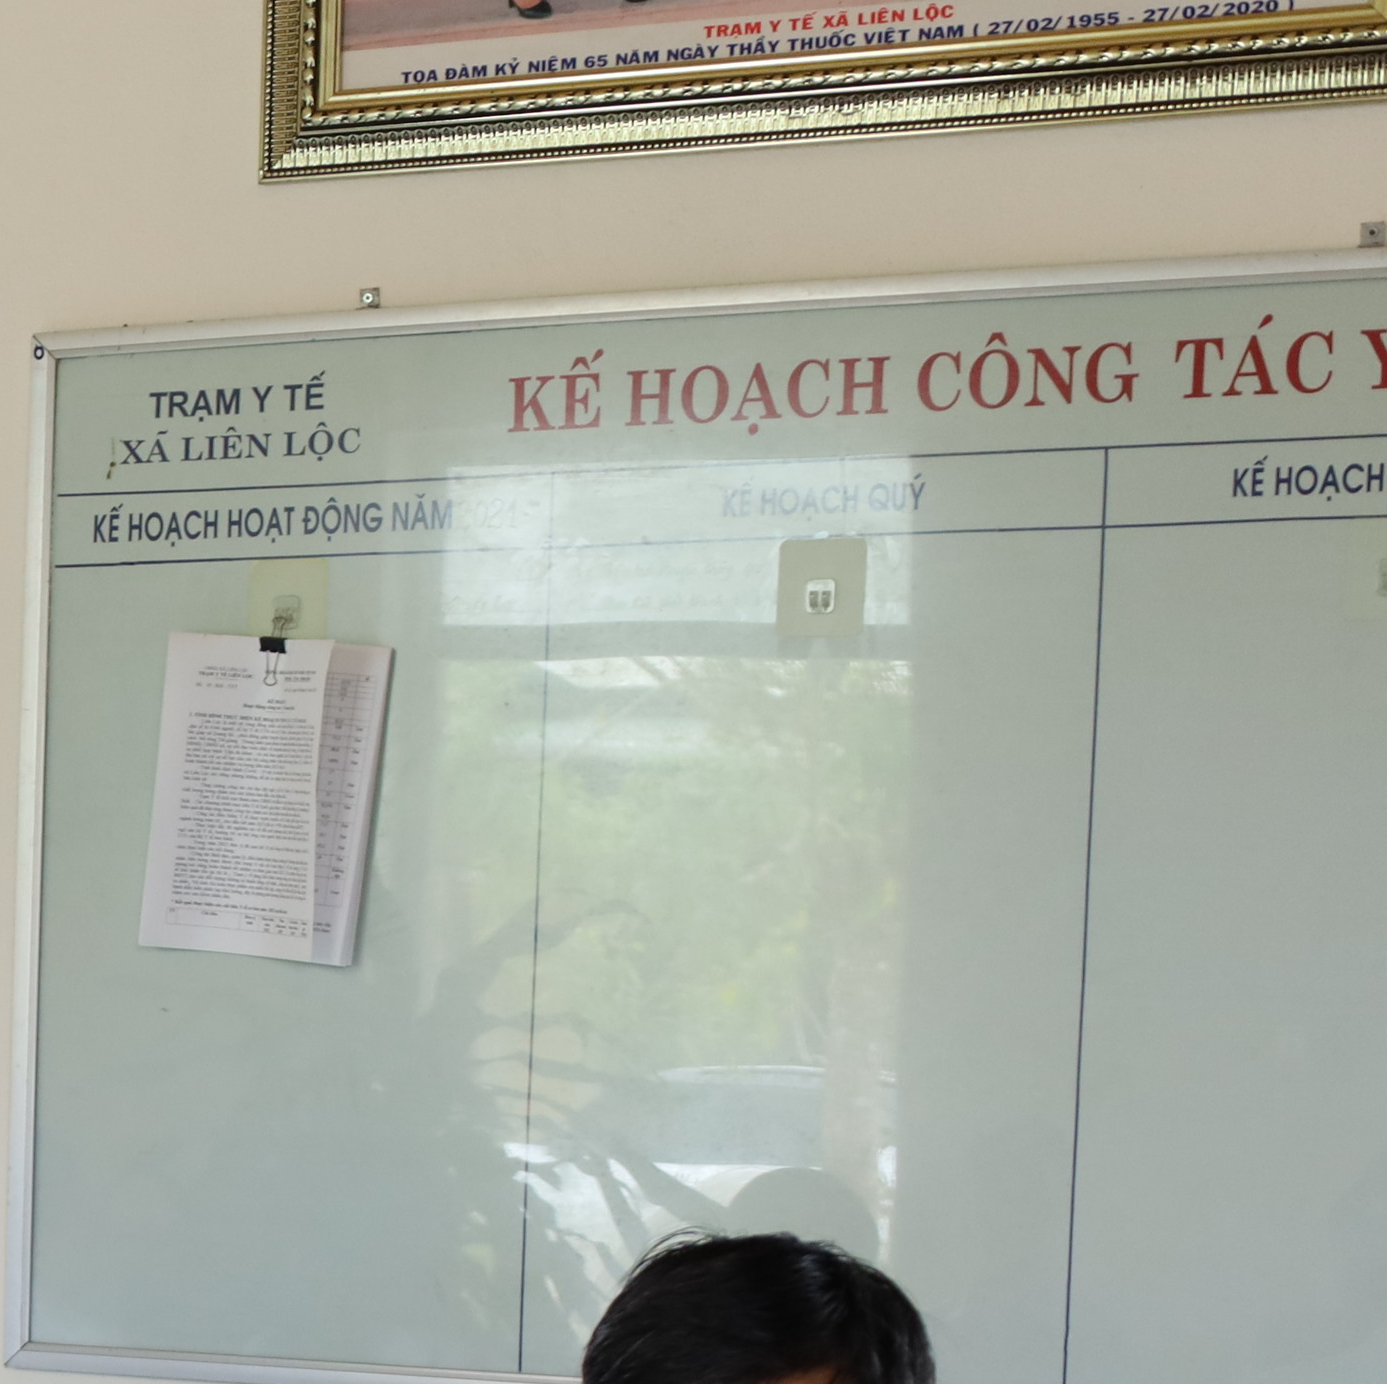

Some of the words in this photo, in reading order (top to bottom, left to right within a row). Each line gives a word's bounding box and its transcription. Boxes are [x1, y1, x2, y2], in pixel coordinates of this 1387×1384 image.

[401, 68, 439, 86] TỌA
[445, 59, 488, 81] ĐÀM
[495, 54, 524, 77] KỶ
[528, 52, 577, 76] NIỆM
[583, 54, 608, 69] 65
[615, 44, 660, 67] NĂM
[666, 38, 721, 62] NGÀY
[788, 25, 857, 52] THUỐC
[862, 26, 912, 48] VIỆT
[918, 24, 965, 42] NAM
[987, 10, 1120, 38] 27/02/1955
[1142, 0, 1280, 24] 27/02/2020
[704, 21, 764, 42] TRẠM
[769, 19, 783, 35] Y
[787, 12, 816, 35] TẾ
[823, 10, 850, 30] XÃ
[857, 5, 907, 27] LIÊN
[911, 2, 956, 24] LỘC
[150, 386, 242, 423] TRẠM
[251, 384, 274, 413] Y
[284, 370, 326, 412] TẾ
[507, 348, 606, 434] KẾ
[624, 354, 891, 436] HOẠCH
[917, 331, 1140, 412] CÔNG
[1174, 313, 1335, 400] TÁC
[119, 429, 171, 465] XÃ
[180, 423, 278, 462] LIÊN
[284, 421, 362, 461] LỘC
[721, 477, 754, 519] KẾ
[761, 484, 858, 521] HOẠCH
[868, 473, 927, 512] QUÝ
[1232, 456, 1268, 498] KẾ
[1274, 462, 1385, 502] HOẠCH
[91, 502, 124, 544] KẾ
[128, 508, 220, 547] HOẠCH
[228, 503, 295, 544] HOẠT
[302, 497, 384, 539] ĐỘNG
[390, 492, 453, 532] NĂM
